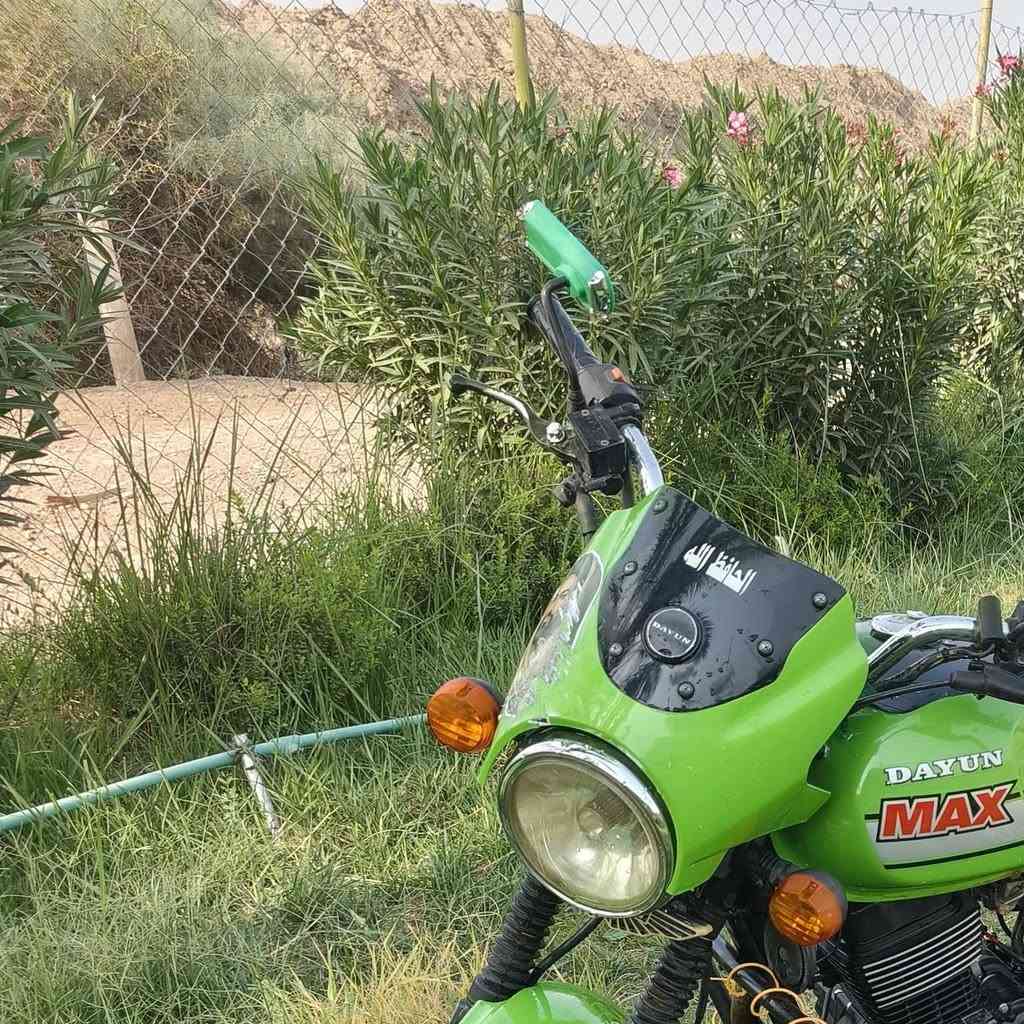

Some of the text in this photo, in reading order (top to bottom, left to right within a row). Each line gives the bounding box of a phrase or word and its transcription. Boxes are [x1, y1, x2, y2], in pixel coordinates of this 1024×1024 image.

[683, 542, 717, 572] الله
[884, 750, 1003, 785] DAYUN
[877, 782, 1015, 842] MAX
